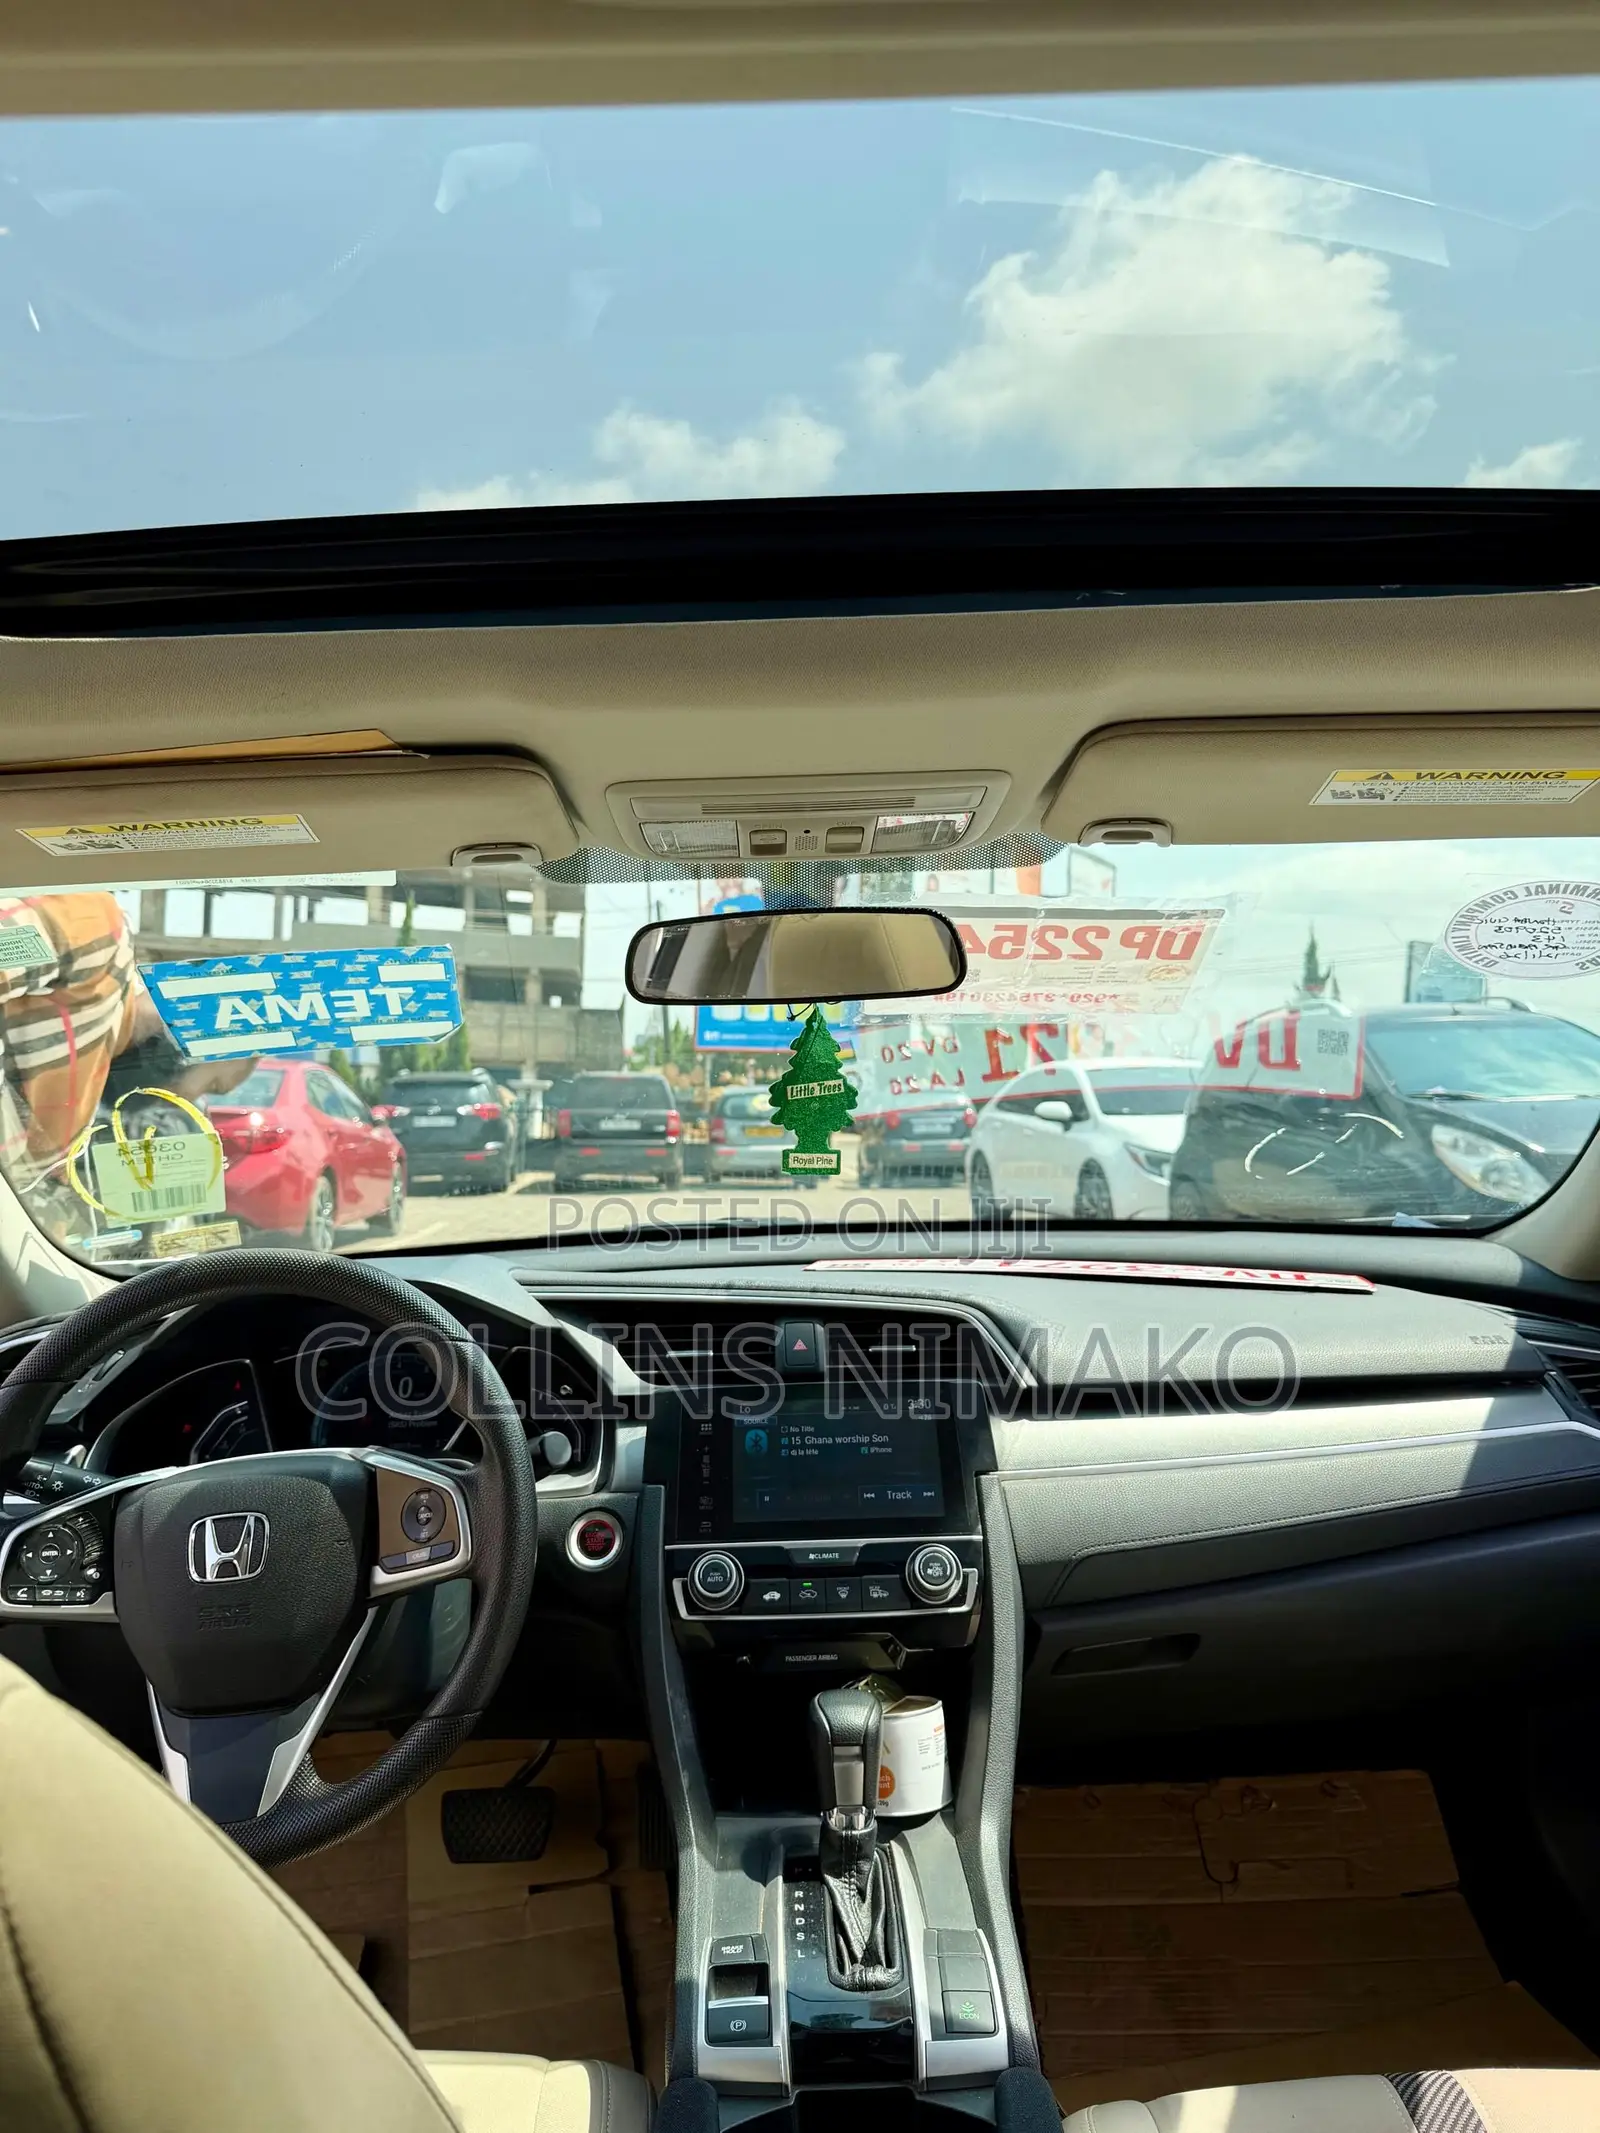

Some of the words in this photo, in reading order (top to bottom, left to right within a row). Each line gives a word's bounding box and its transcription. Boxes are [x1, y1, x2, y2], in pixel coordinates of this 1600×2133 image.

[1416, 771, 1568, 780] WARNING
[108, 817, 263, 832] WARNING
[790, 1085, 815, 1099] Little
[817, 1081, 842, 1094] Trees
[792, 1156, 815, 1166] Royal
[816, 1156, 833, 1165] Pine
[907, 1398, 931, 1410] 3:30
[789, 1425, 800, 1433] No
[801, 1425, 815, 1433] Title
[791, 1436, 801, 1445] 15
[805, 1435, 833, 1445] Ghana
[835, 1434, 870, 1445] worship
[871, 1434, 889, 1443] Son
[887, 1490, 912, 1500] Track
[814, 1552, 841, 1560] CLIMATE
[785, 1654, 818, 1662] PASSENGER
[818, 1653, 839, 1661] AIRBAG
[794, 1903, 805, 1911] N
[795, 1917, 806, 1925] D
[796, 1932, 805, 1940] S
[797, 1949, 806, 1958] L
[959, 2012, 980, 2020] ECON
